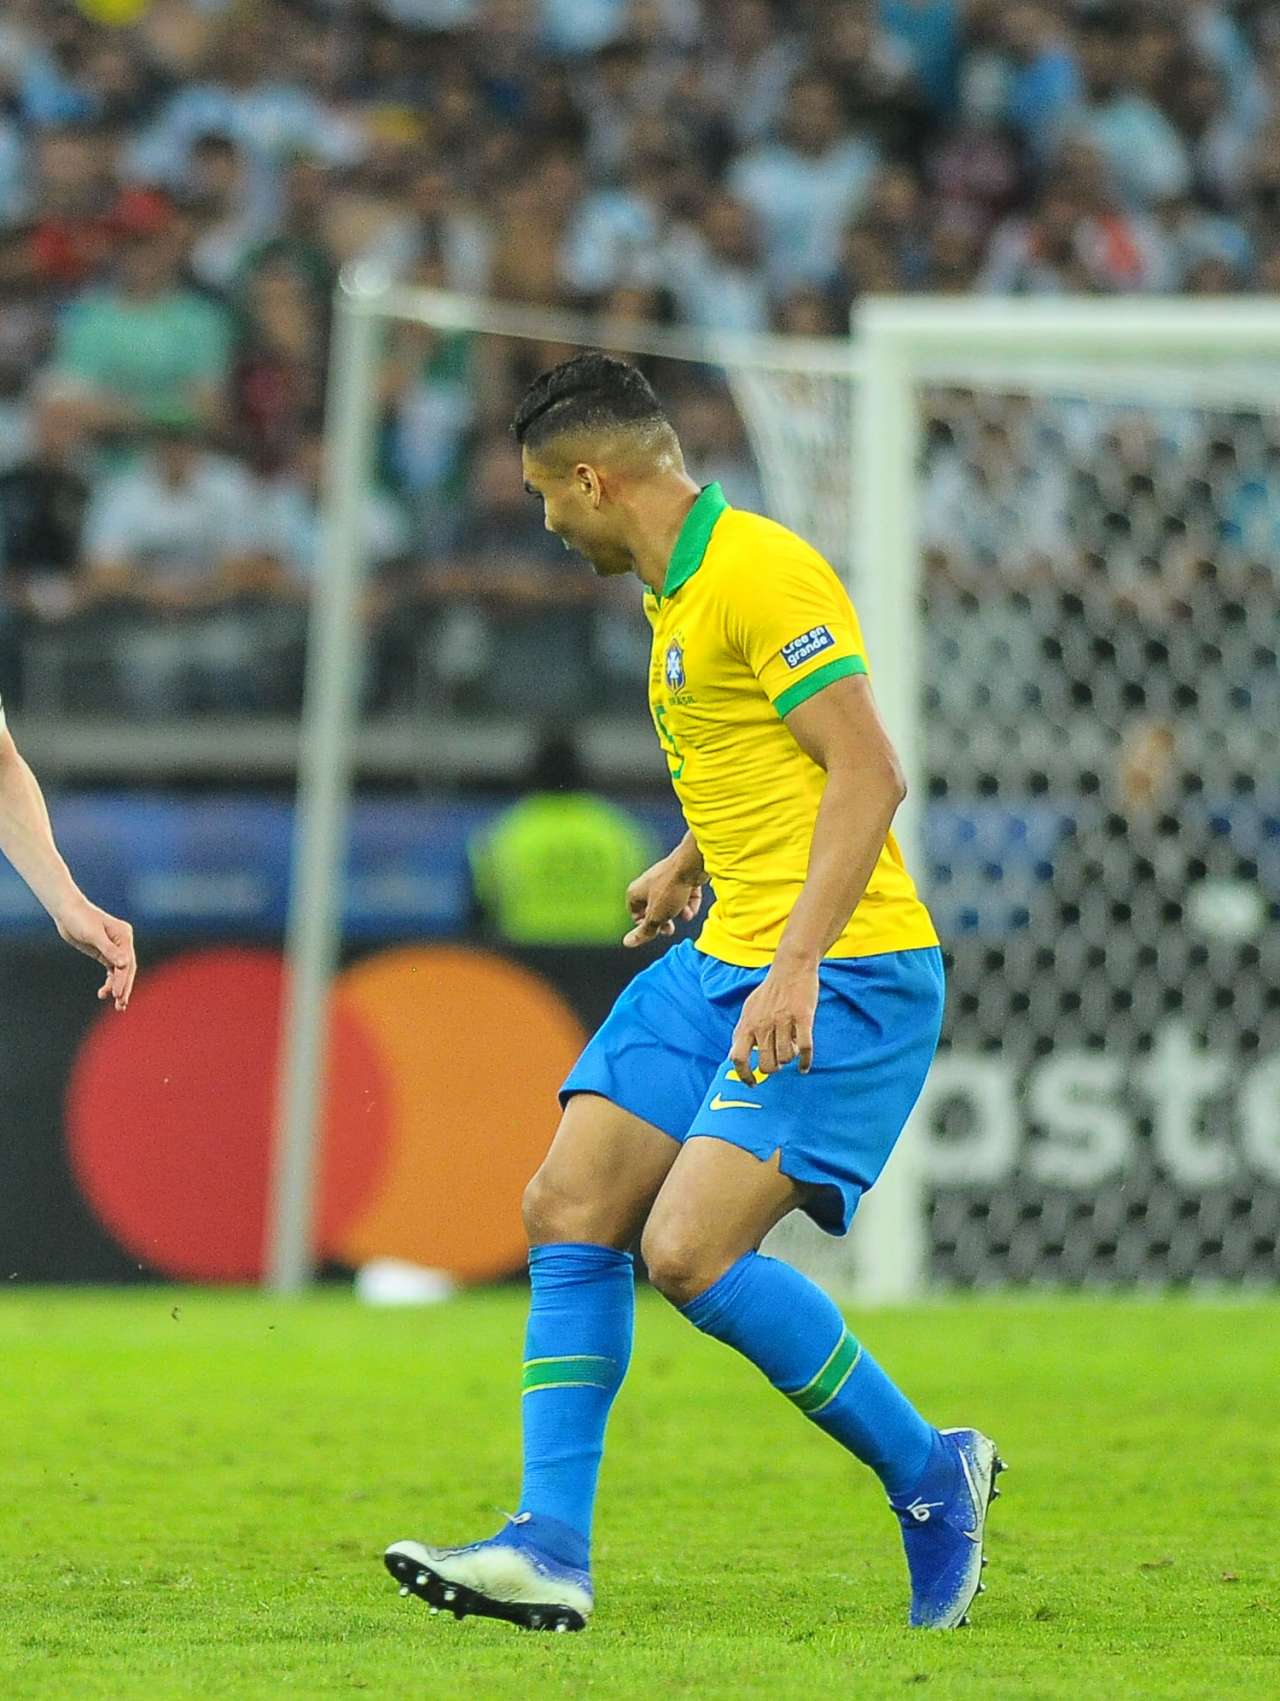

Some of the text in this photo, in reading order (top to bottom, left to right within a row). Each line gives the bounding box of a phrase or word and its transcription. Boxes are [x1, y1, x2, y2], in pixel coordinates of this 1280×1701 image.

[782, 626, 826, 654] Cree en
[787, 635, 828, 666] grande
